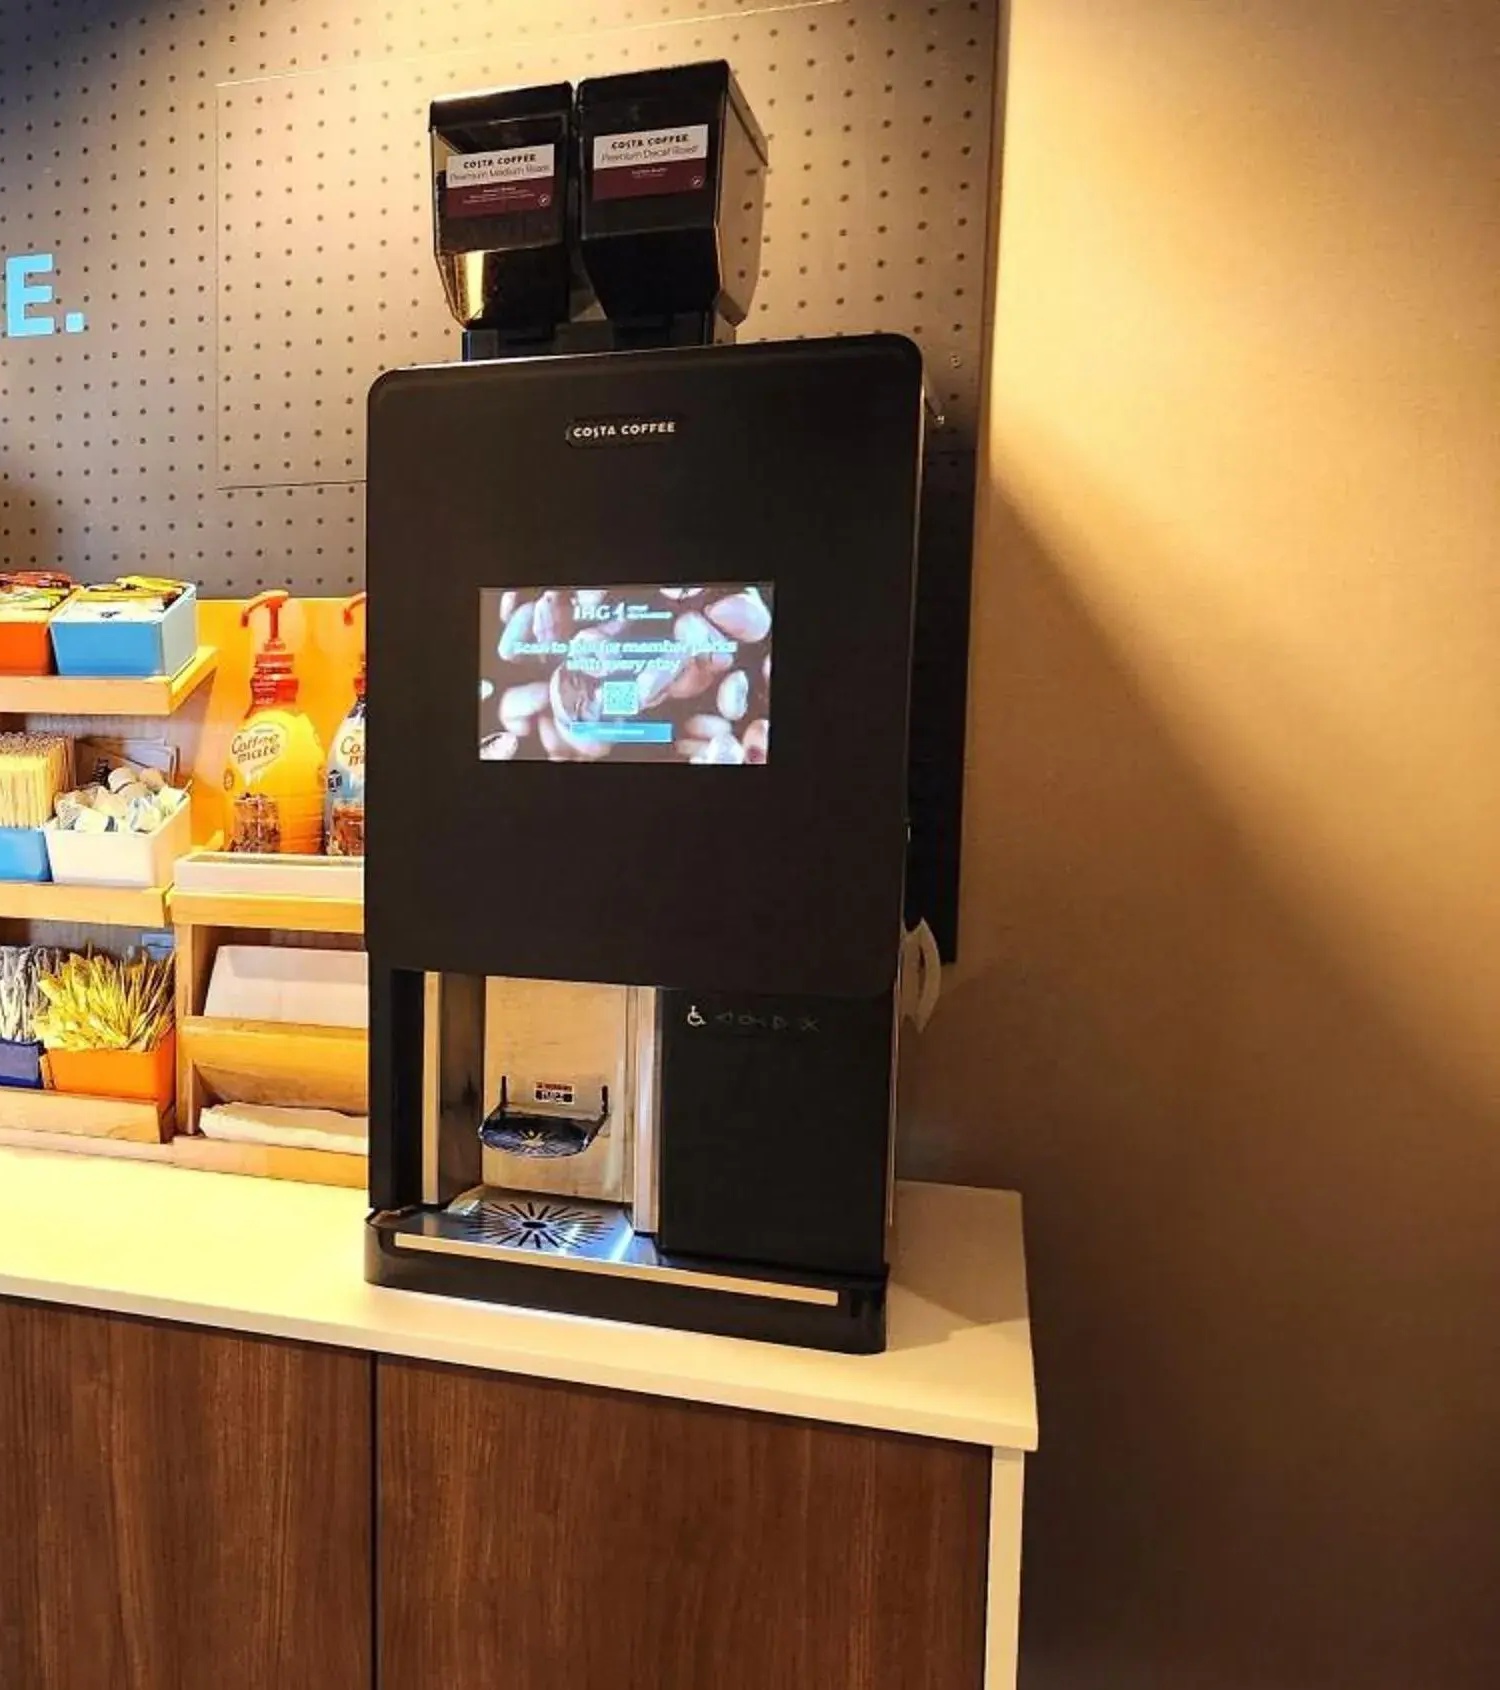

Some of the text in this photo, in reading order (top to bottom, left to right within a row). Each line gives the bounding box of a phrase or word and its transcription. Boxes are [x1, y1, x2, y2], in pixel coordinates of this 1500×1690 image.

[612, 133, 688, 150] COSTA COFFEE
[463, 153, 537, 169] COSTA COFFEE
[572, 421, 677, 439] COSTA COFFEE
[231, 733, 280, 755] Coffee
[236, 743, 281, 764] mate
